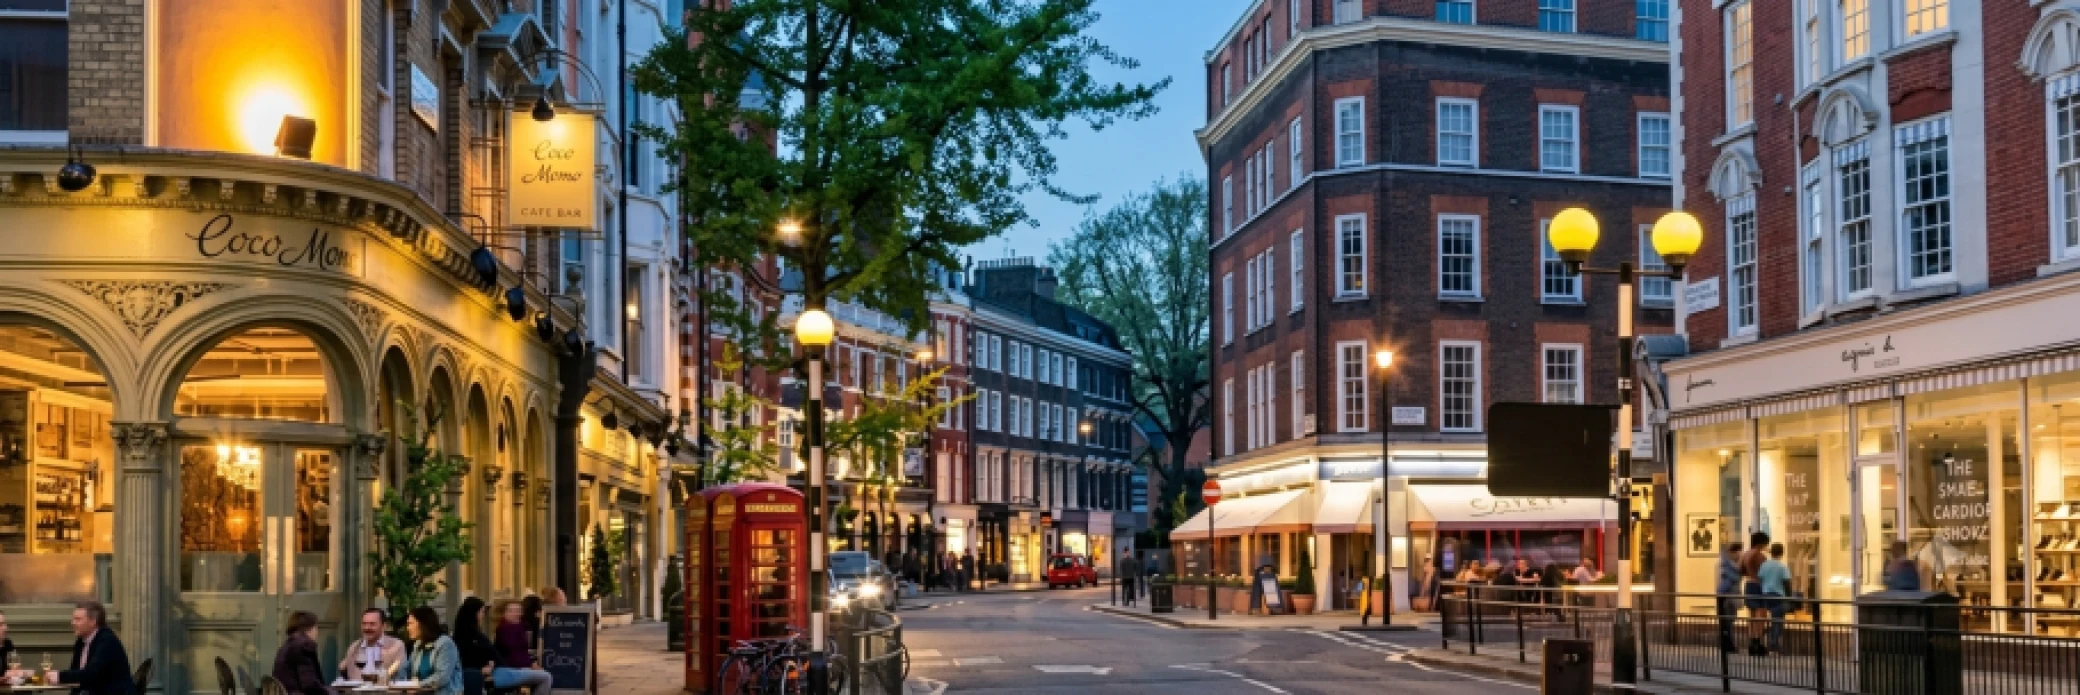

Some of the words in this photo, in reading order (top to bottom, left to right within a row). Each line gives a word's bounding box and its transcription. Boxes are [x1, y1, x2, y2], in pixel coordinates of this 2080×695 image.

[530, 139, 575, 160] Coco
[521, 164, 582, 184] Momo
[557, 208, 582, 218] BAR
[185, 214, 282, 257] Coco
[1943, 457, 1973, 476] THE
